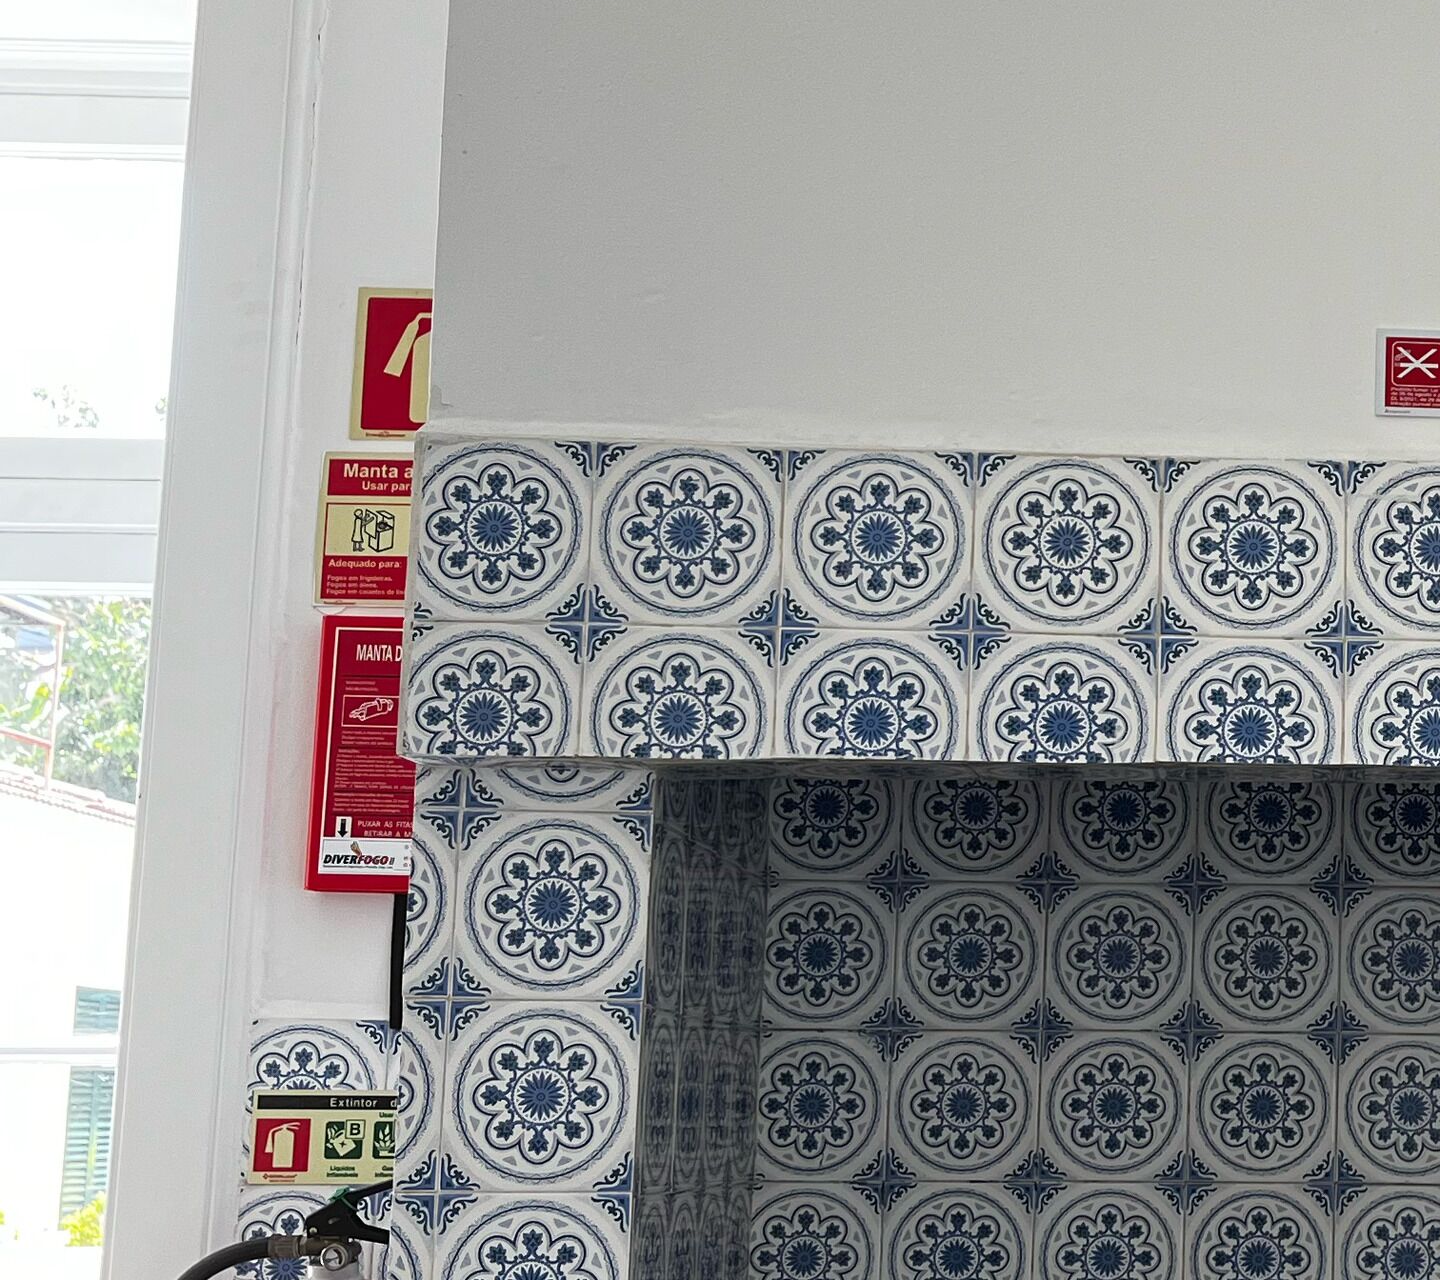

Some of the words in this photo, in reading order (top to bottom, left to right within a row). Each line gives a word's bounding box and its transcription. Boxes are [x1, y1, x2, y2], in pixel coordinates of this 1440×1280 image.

[344, 463, 398, 478] Manta
[362, 481, 388, 490] Usar
[328, 559, 376, 568] Adequado
[356, 645, 392, 661] MANTA
[395, 646, 403, 661] D
[324, 854, 389, 865] DIVERFOGO
[330, 1098, 378, 1107] Extintor
[350, 1124, 360, 1135] B
